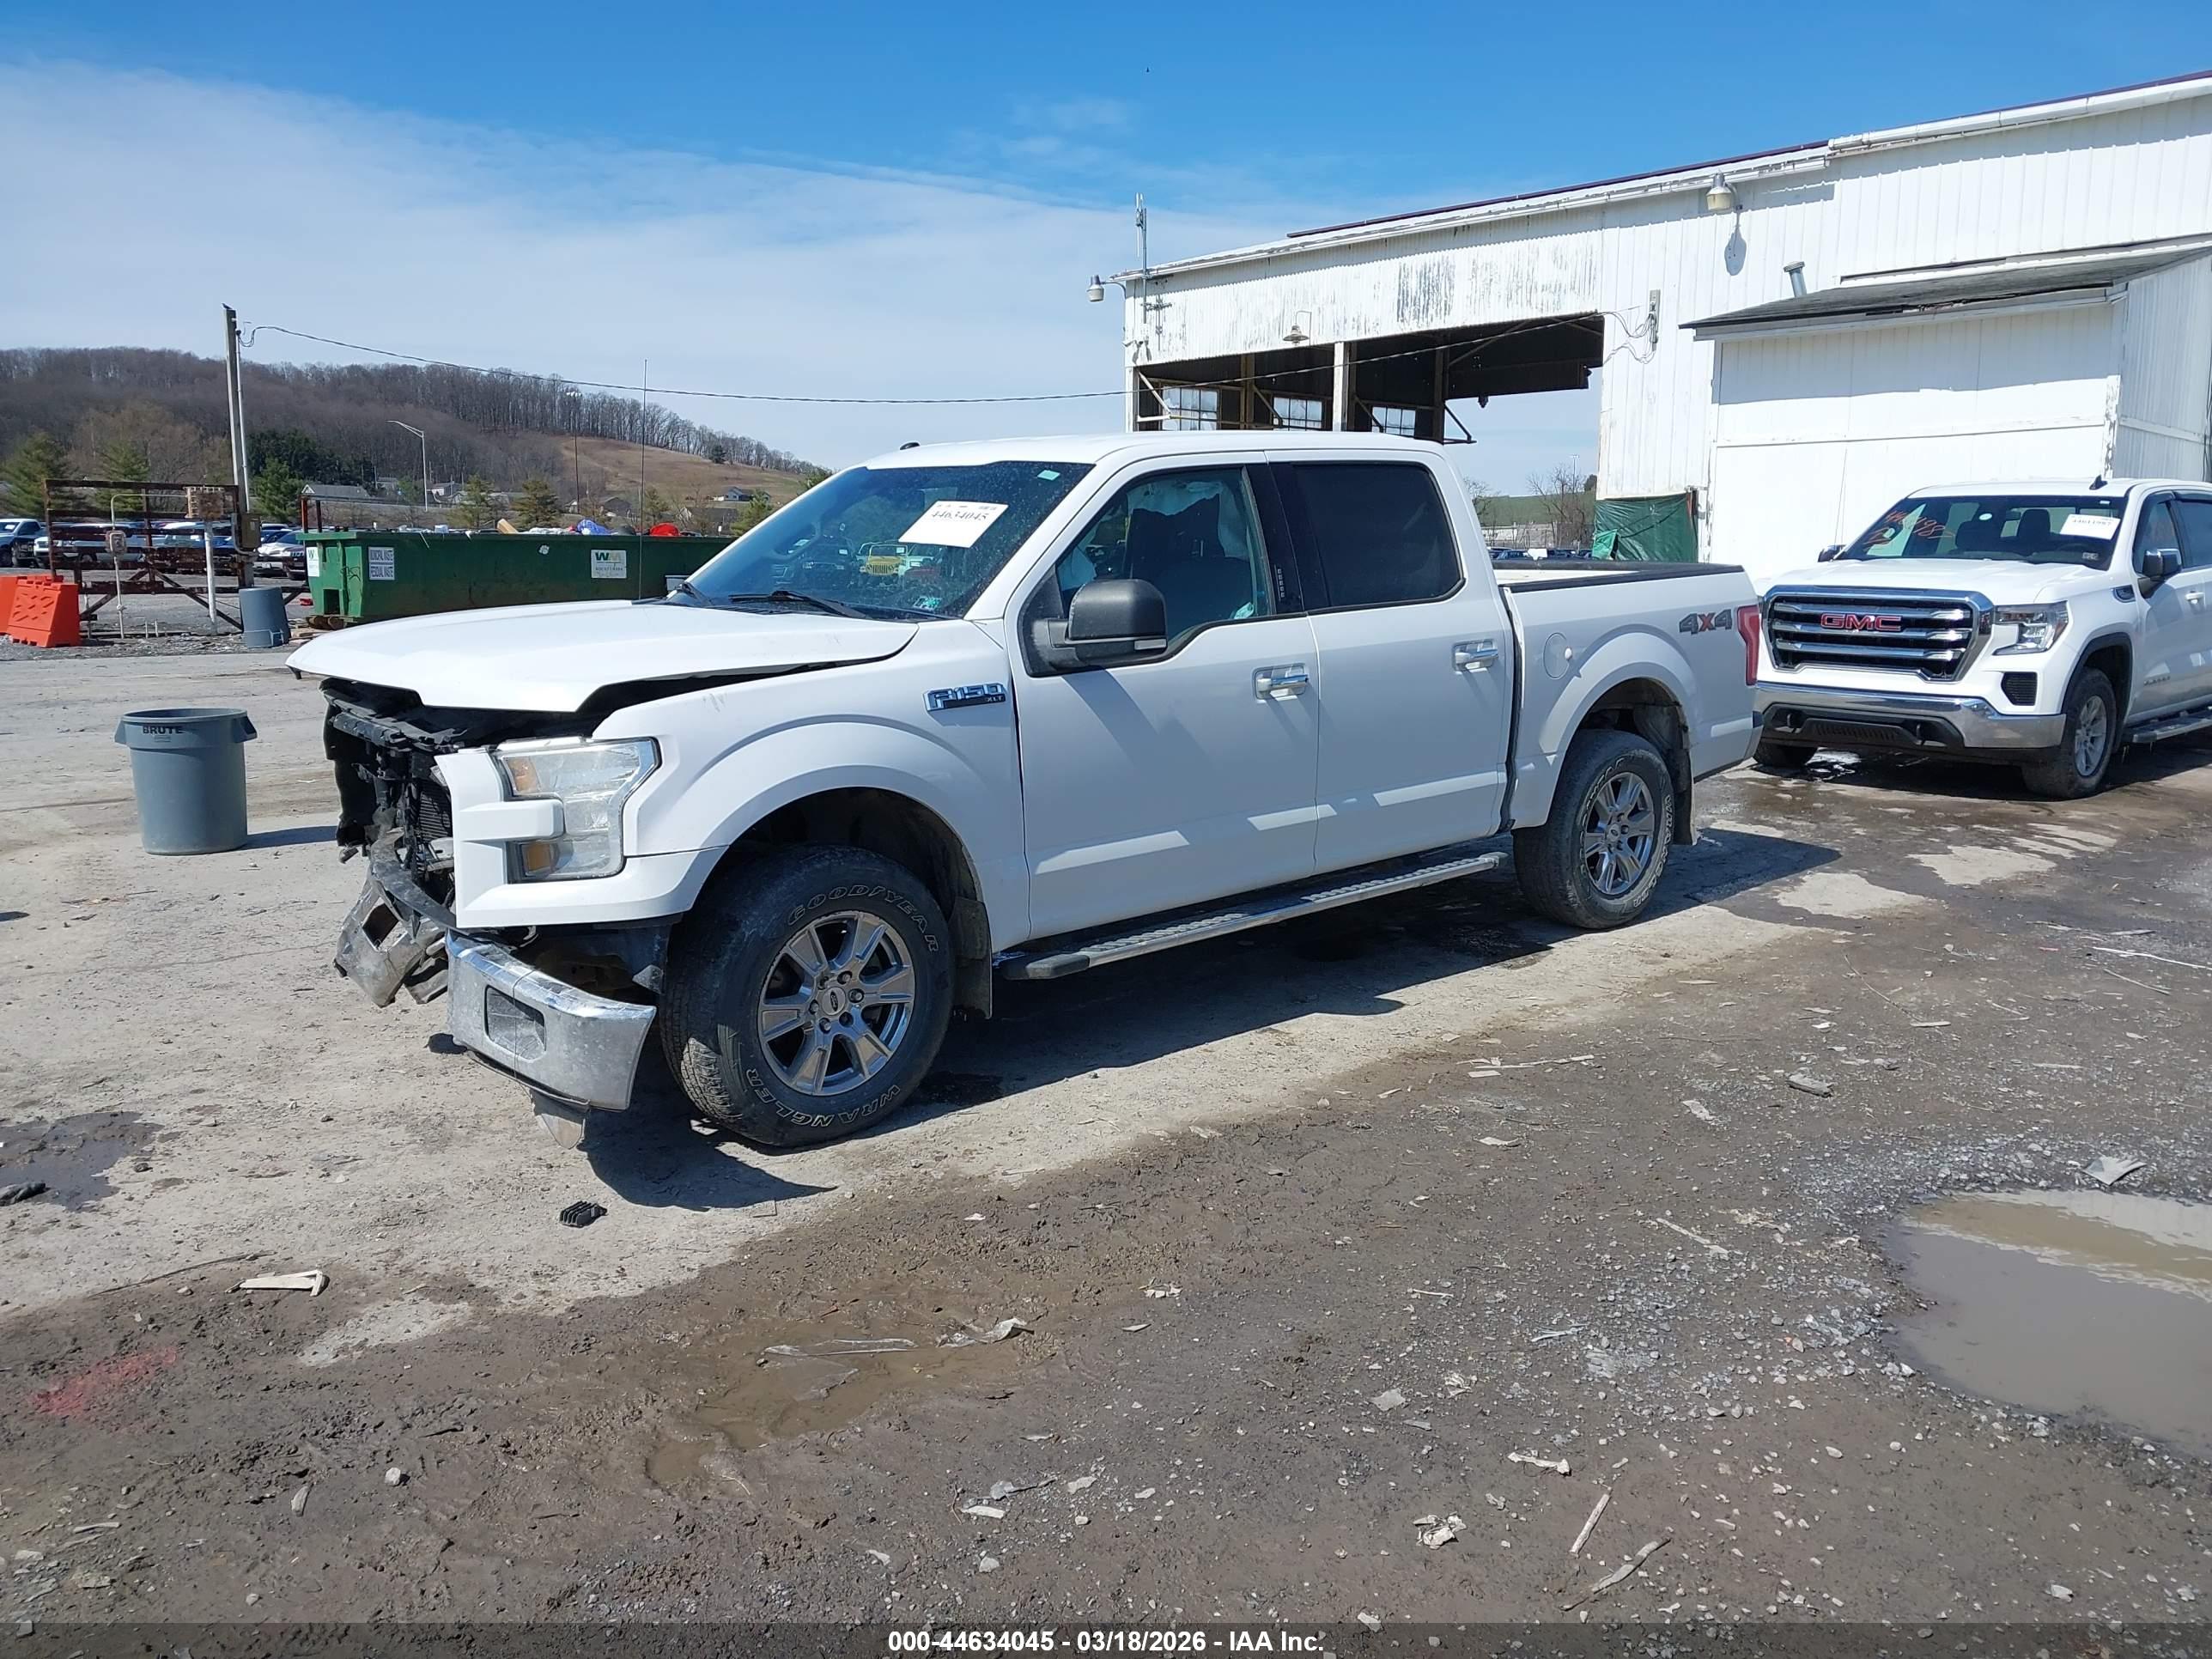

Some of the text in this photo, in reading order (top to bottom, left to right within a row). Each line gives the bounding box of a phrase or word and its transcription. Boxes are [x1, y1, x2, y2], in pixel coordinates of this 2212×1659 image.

[1820, 612, 1902, 632] GMC
[987, 695, 1003, 703] XLT
[143, 725, 184, 735] BRUTE
[787, 884, 939, 952] GOODYEAR
[745, 1068, 901, 1127] WRANGLER
